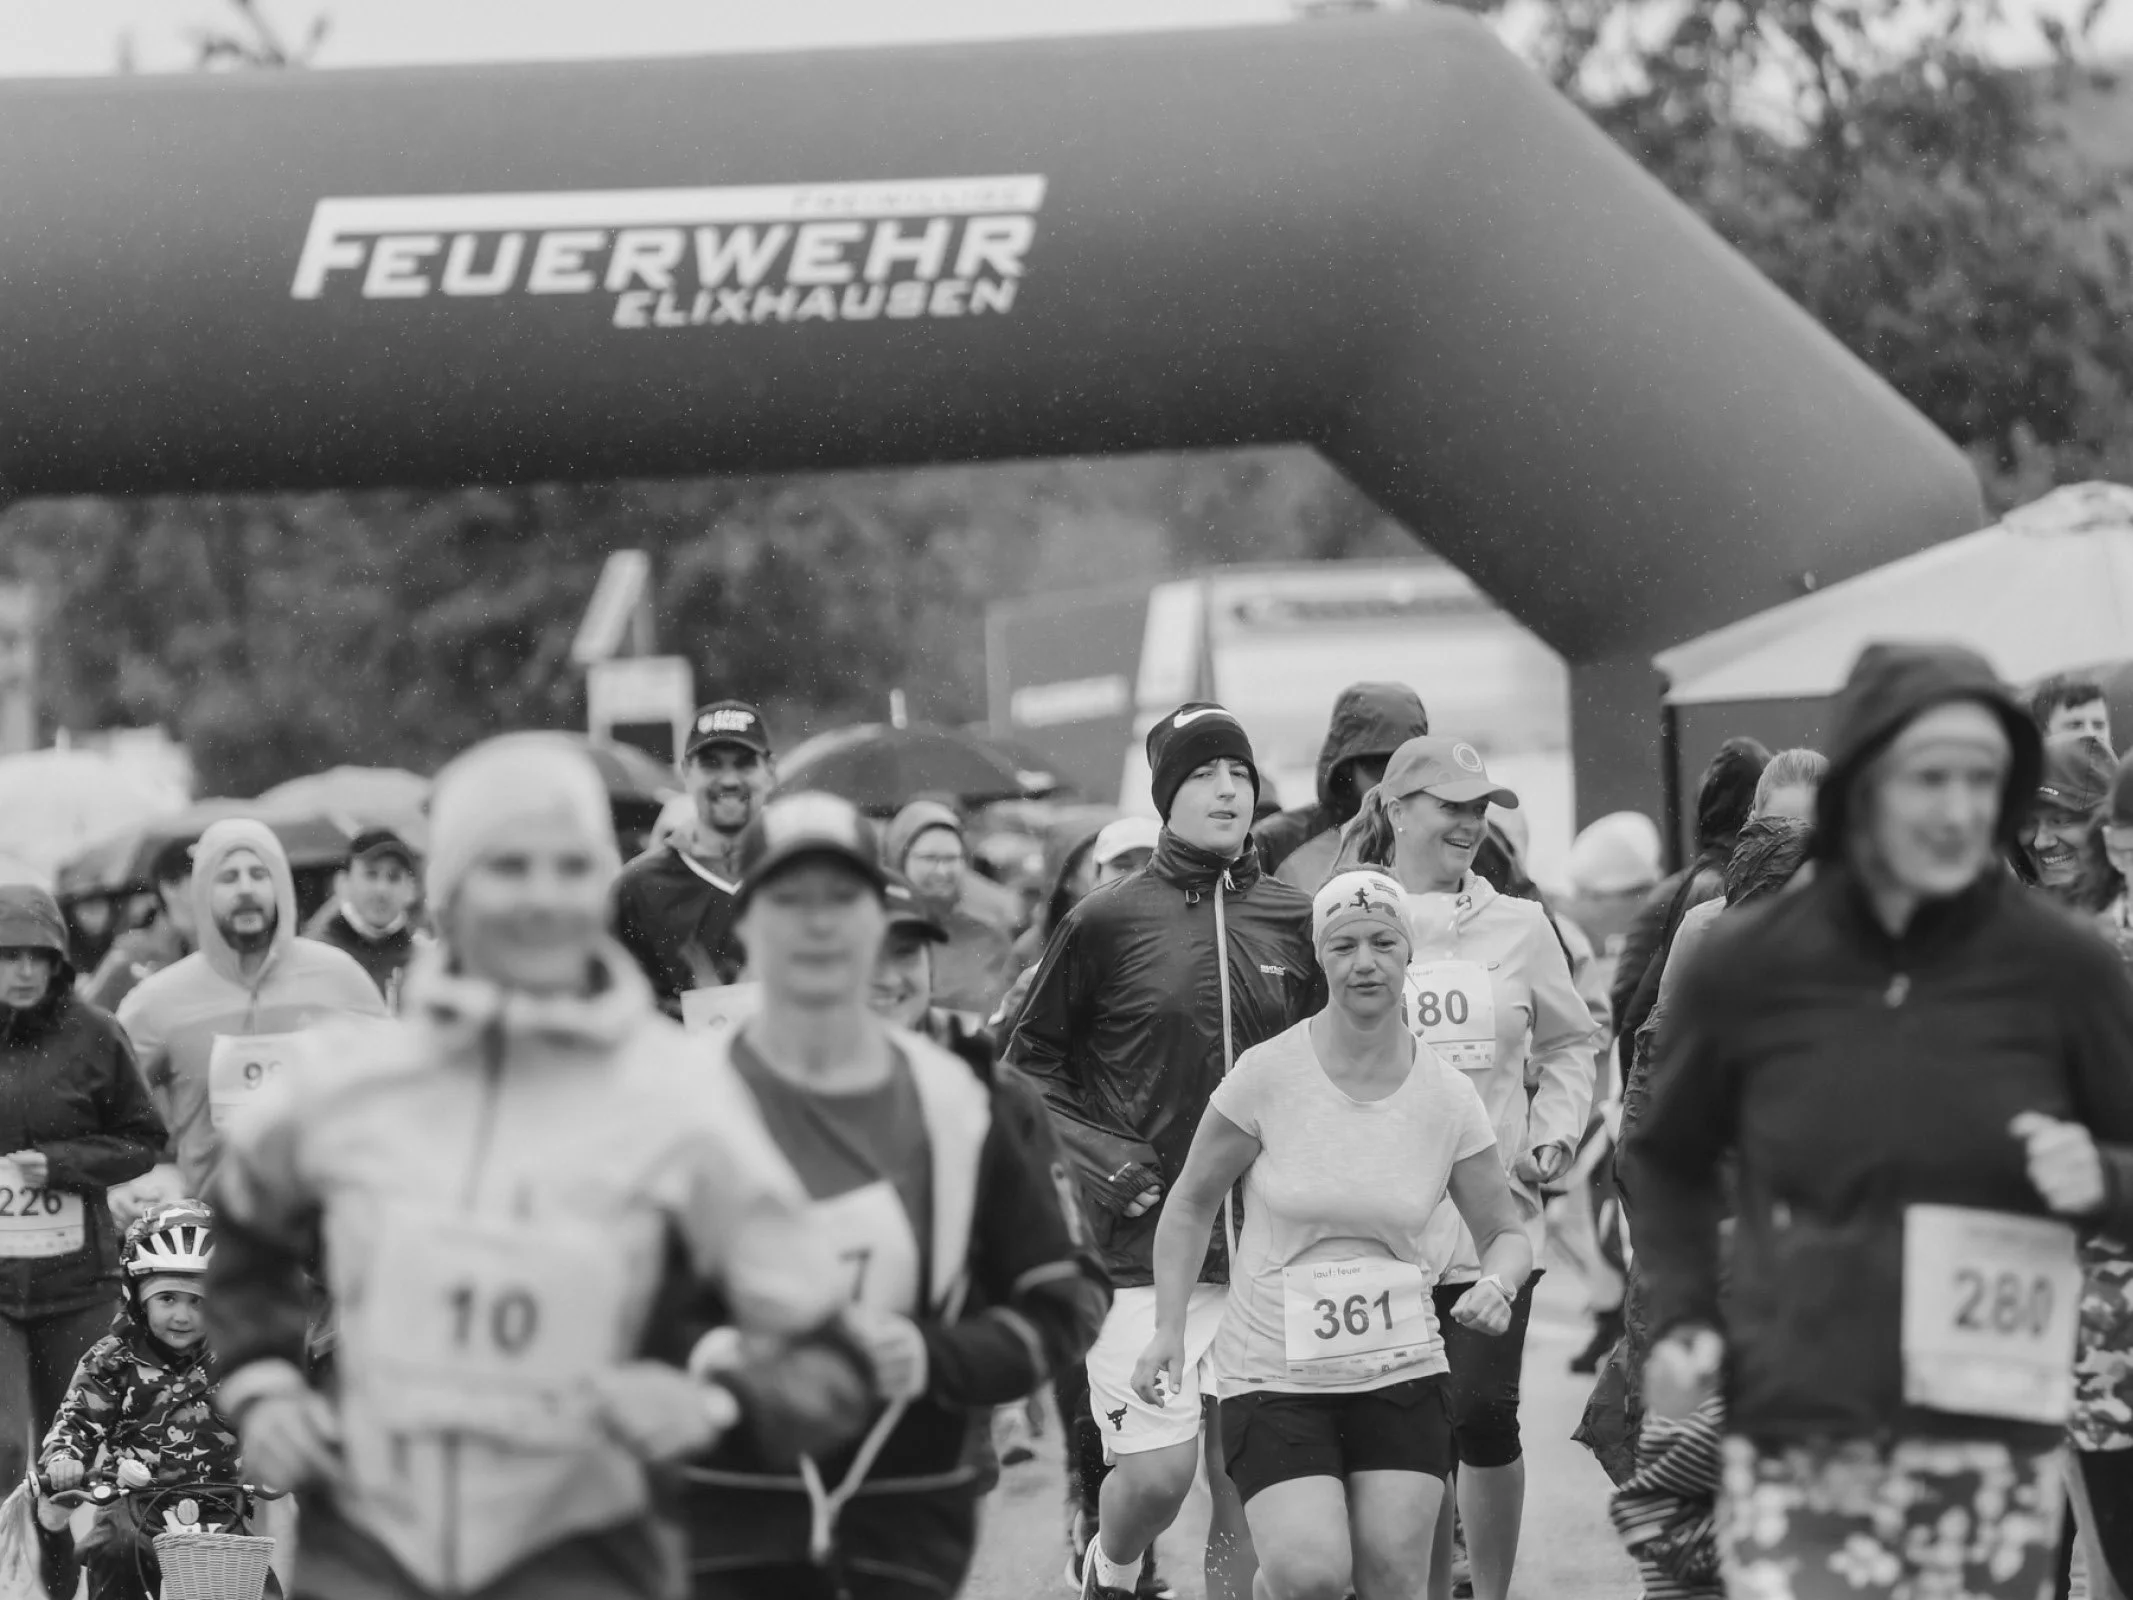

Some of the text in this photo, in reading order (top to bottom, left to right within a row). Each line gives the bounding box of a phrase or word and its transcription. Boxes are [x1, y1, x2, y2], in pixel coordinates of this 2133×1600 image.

[291, 176, 1046, 299] FEUERWEHR
[612, 277, 1019, 328] ELIXHAUSEN
[0, 1187, 62, 1216] 226
[440, 1279, 541, 1357] 10
[1313, 1289, 1393, 1340] 361
